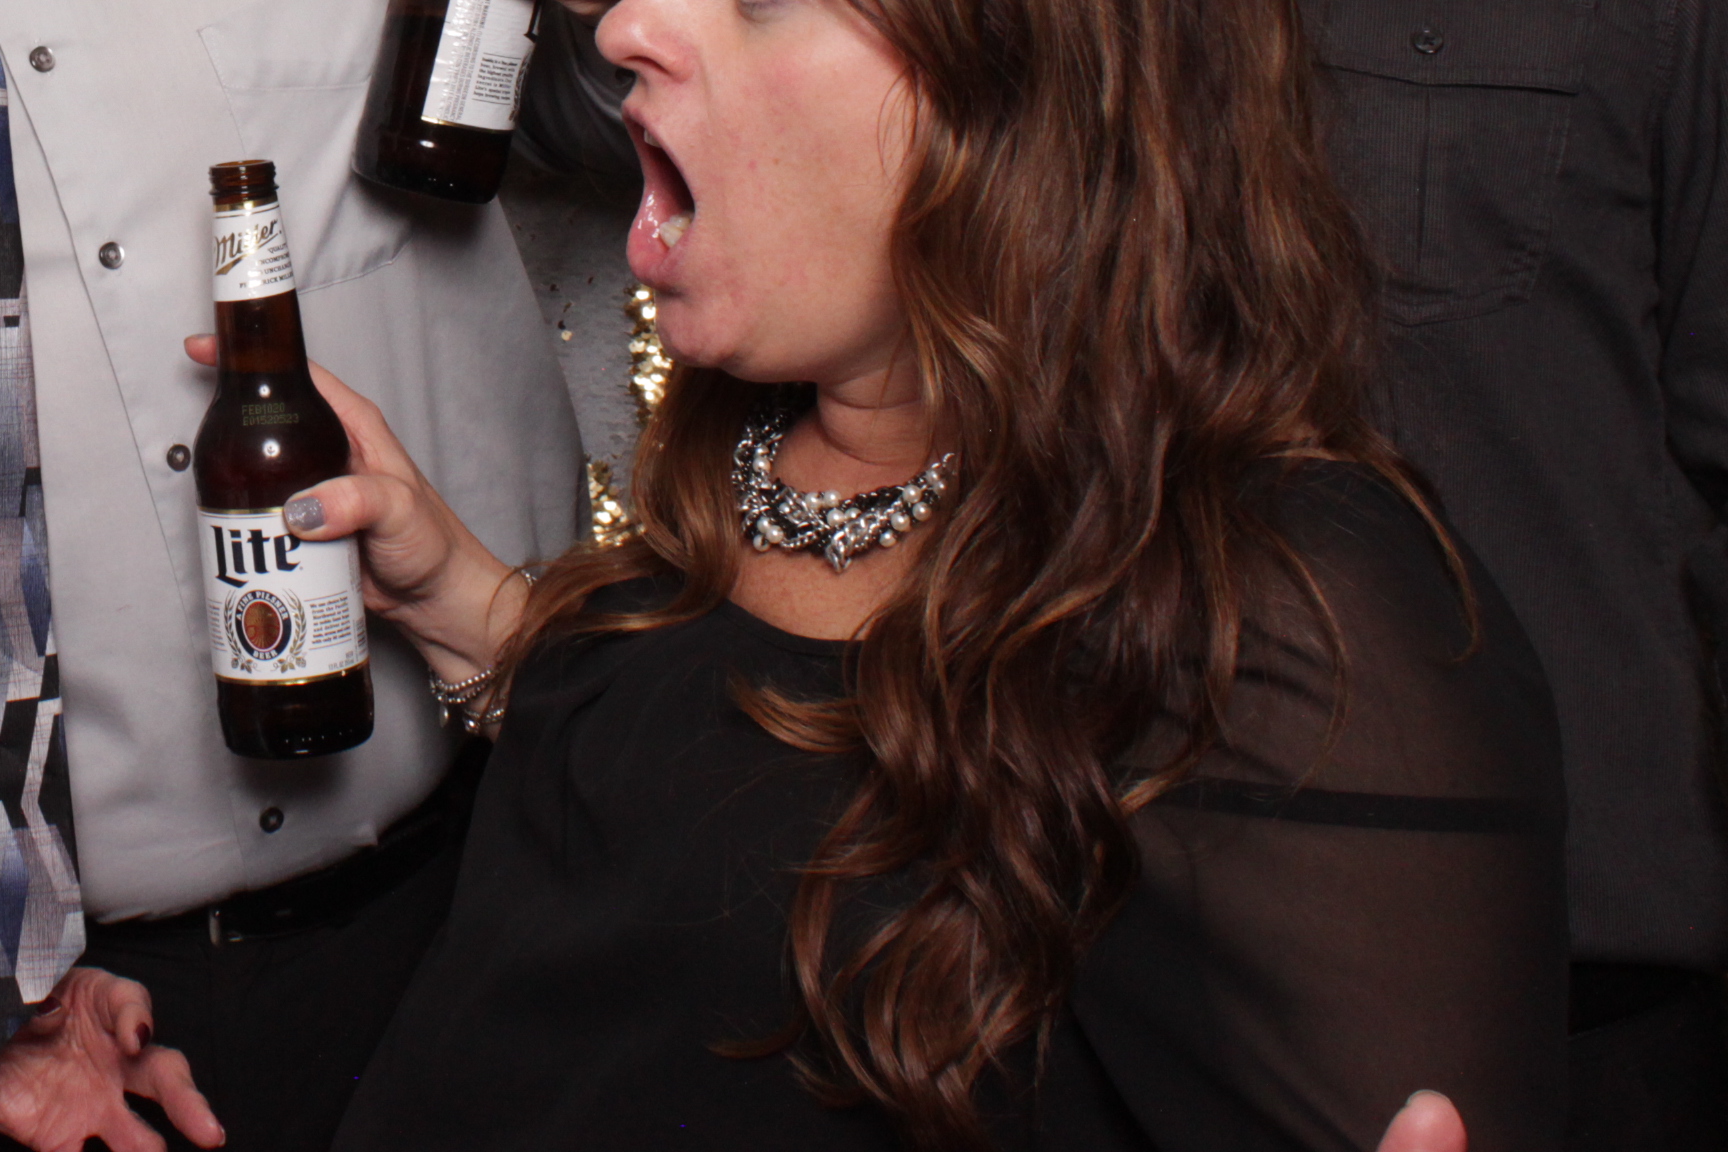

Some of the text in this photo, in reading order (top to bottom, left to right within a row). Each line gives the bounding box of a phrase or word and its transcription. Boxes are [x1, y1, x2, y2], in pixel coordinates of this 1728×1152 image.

[214, 219, 278, 268] Miler
[241, 402, 285, 416] FEB1020
[210, 525, 301, 588] Lite
[237, 593, 253, 612] FINE
[255, 591, 289, 620] PILSNER
[253, 649, 278, 660] BEER
